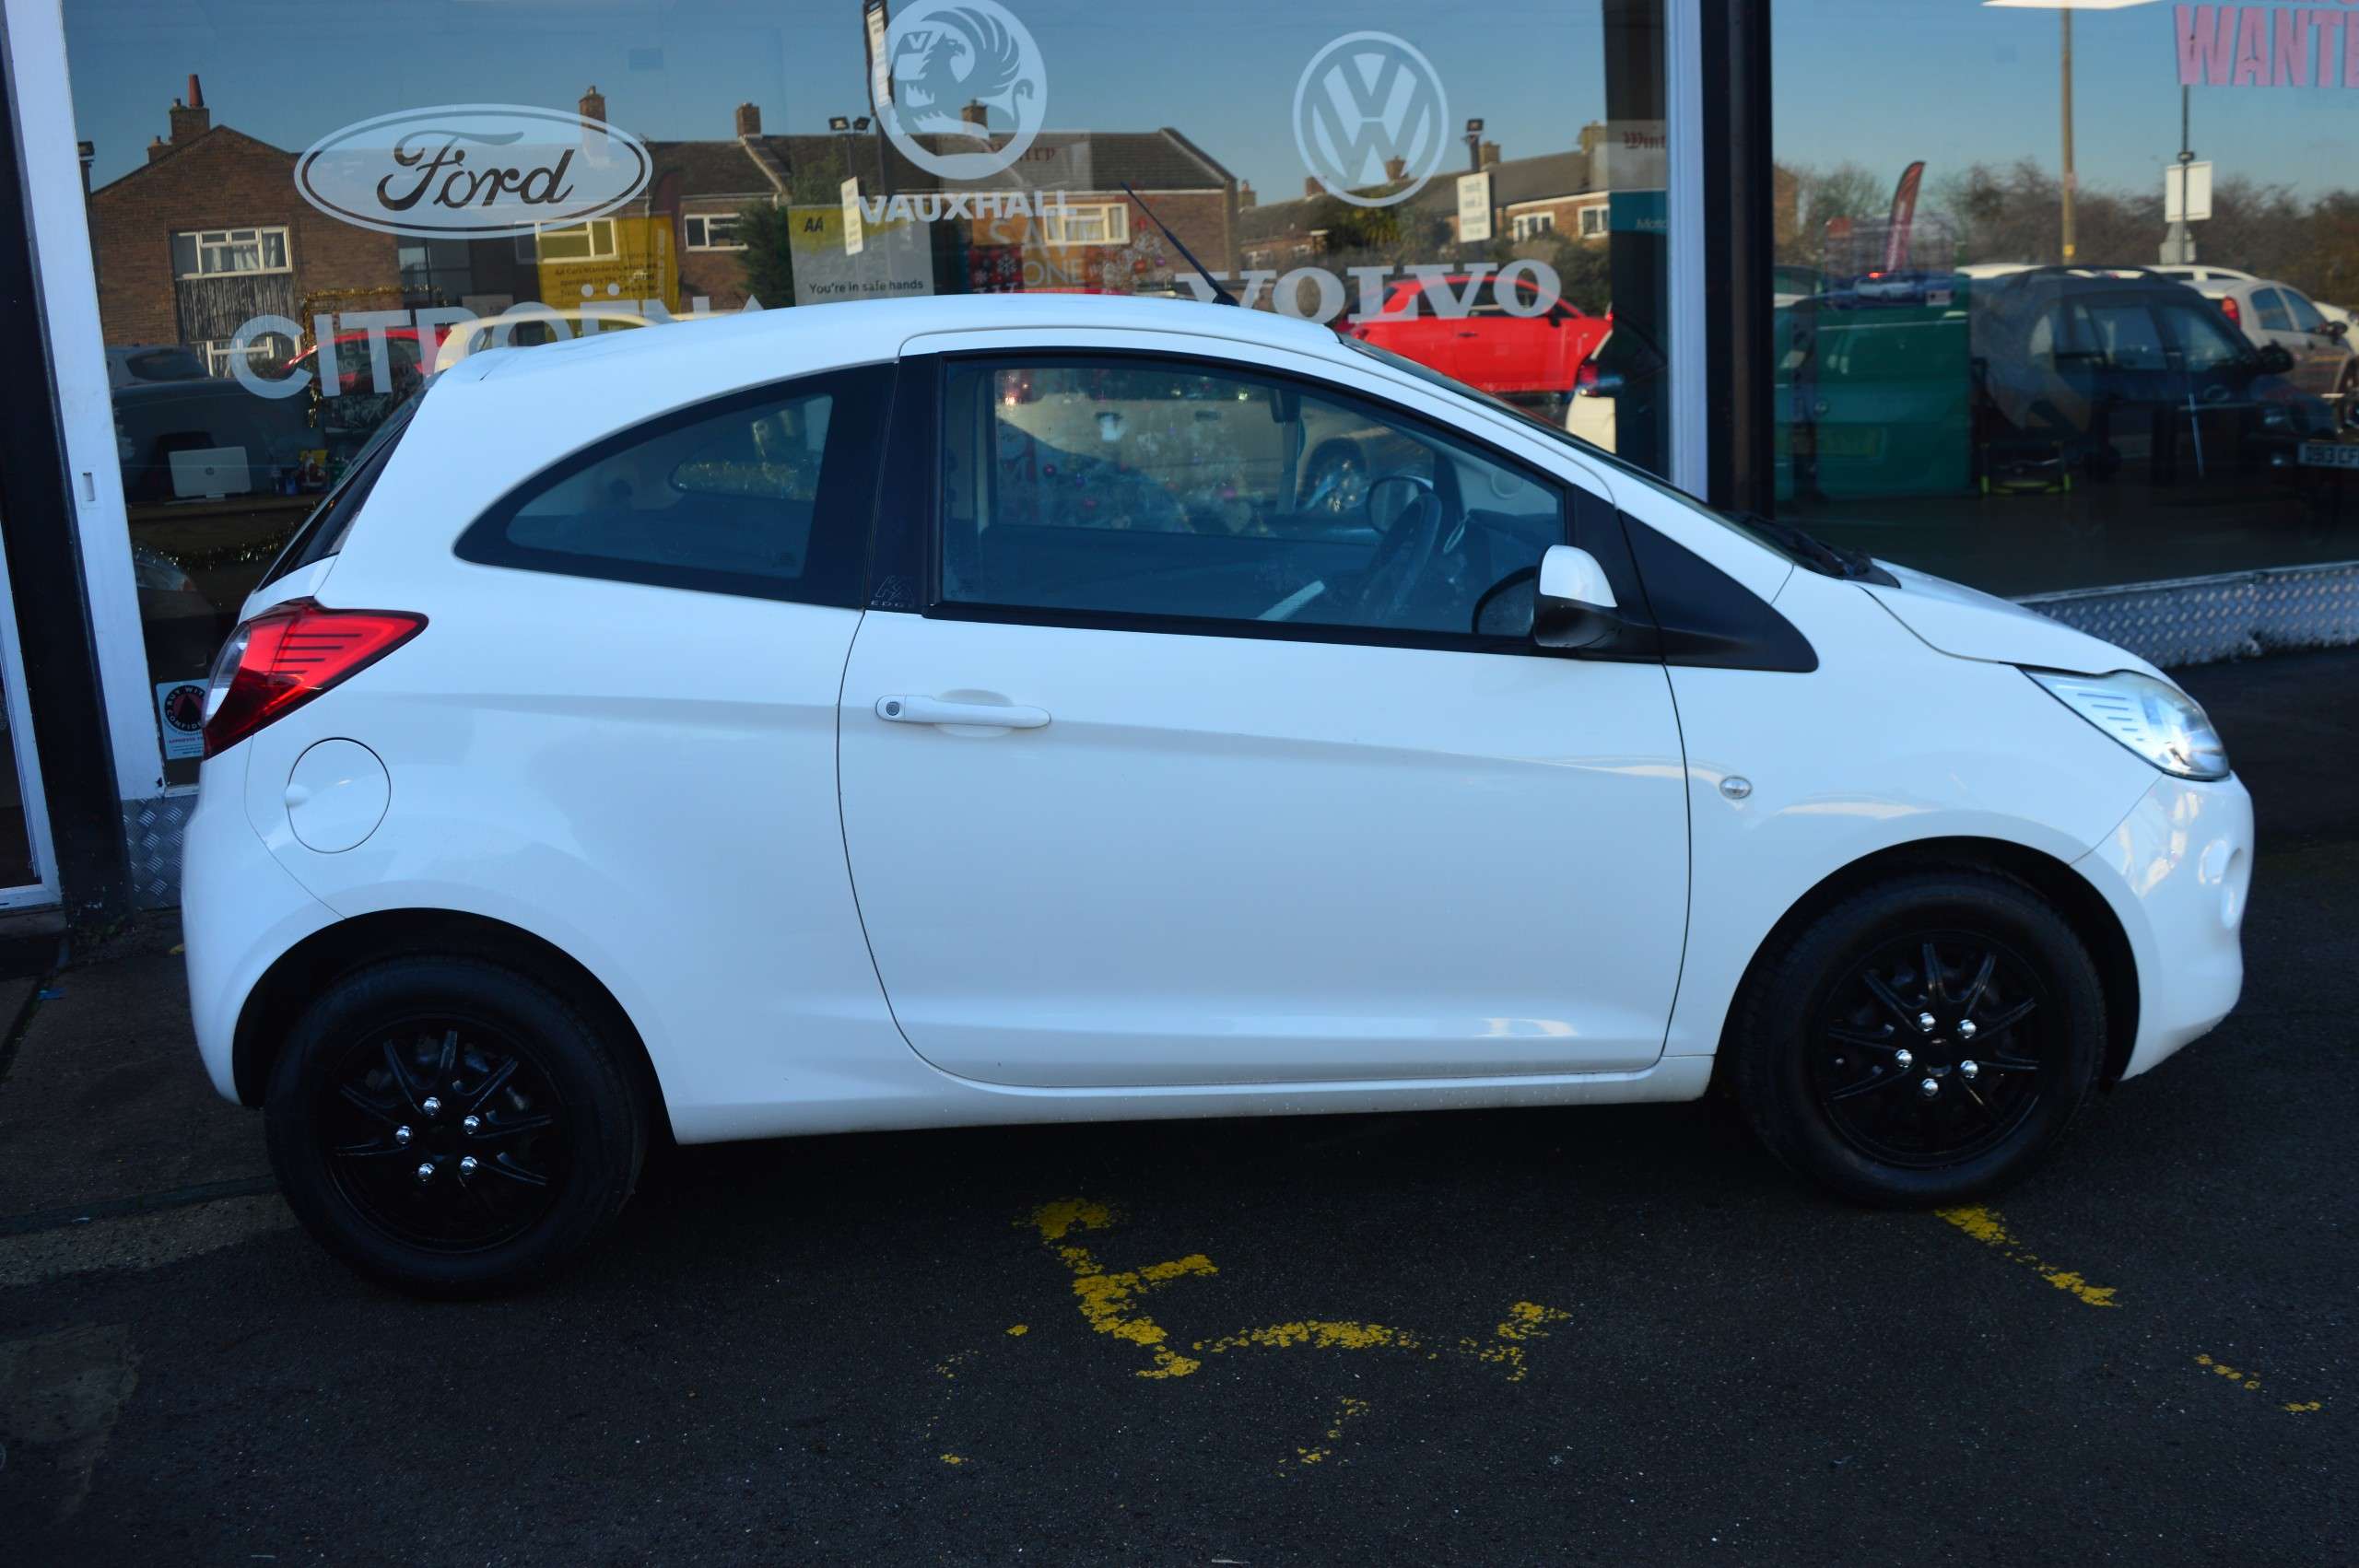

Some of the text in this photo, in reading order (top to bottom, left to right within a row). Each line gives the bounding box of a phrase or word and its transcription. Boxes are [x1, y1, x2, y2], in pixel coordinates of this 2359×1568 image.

[376, 129, 575, 212] Ford
[858, 189, 1077, 224] VAUXHALL
[804, 216, 824, 233] AA
[809, 278, 923, 295] You're in safe hands
[1175, 259, 1562, 325] VOLVO
[166, 686, 205, 707] BUY WIT
